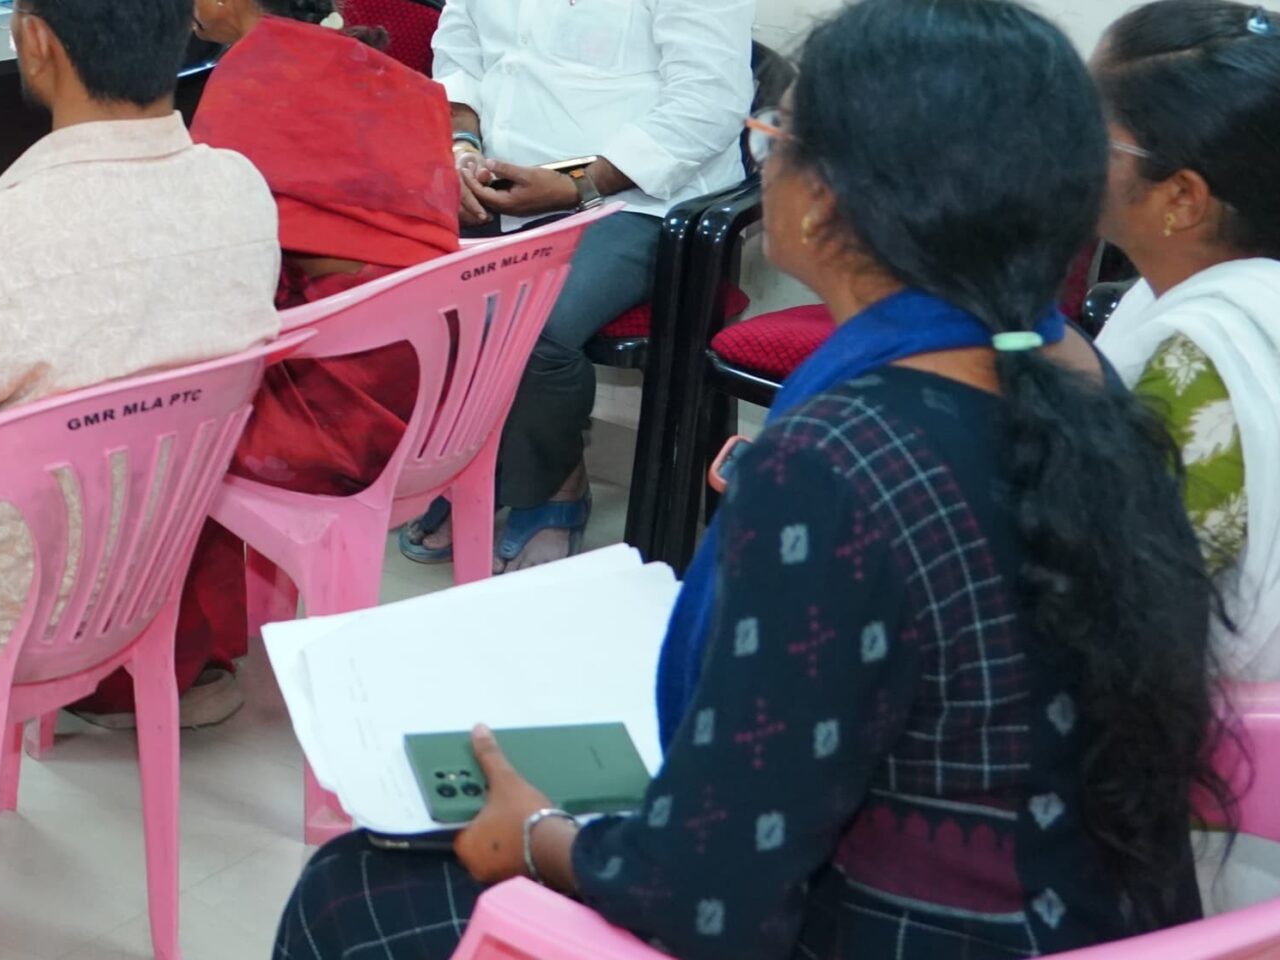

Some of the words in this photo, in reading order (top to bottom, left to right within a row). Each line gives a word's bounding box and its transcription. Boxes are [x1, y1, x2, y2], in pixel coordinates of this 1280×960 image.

[460, 262, 496, 281] GMR
[500, 252, 528, 268] MLA
[531, 246, 553, 260] PTC
[67, 408, 116, 431] GMR
[122, 397, 163, 417] MLA
[169, 389, 202, 406] PTC
